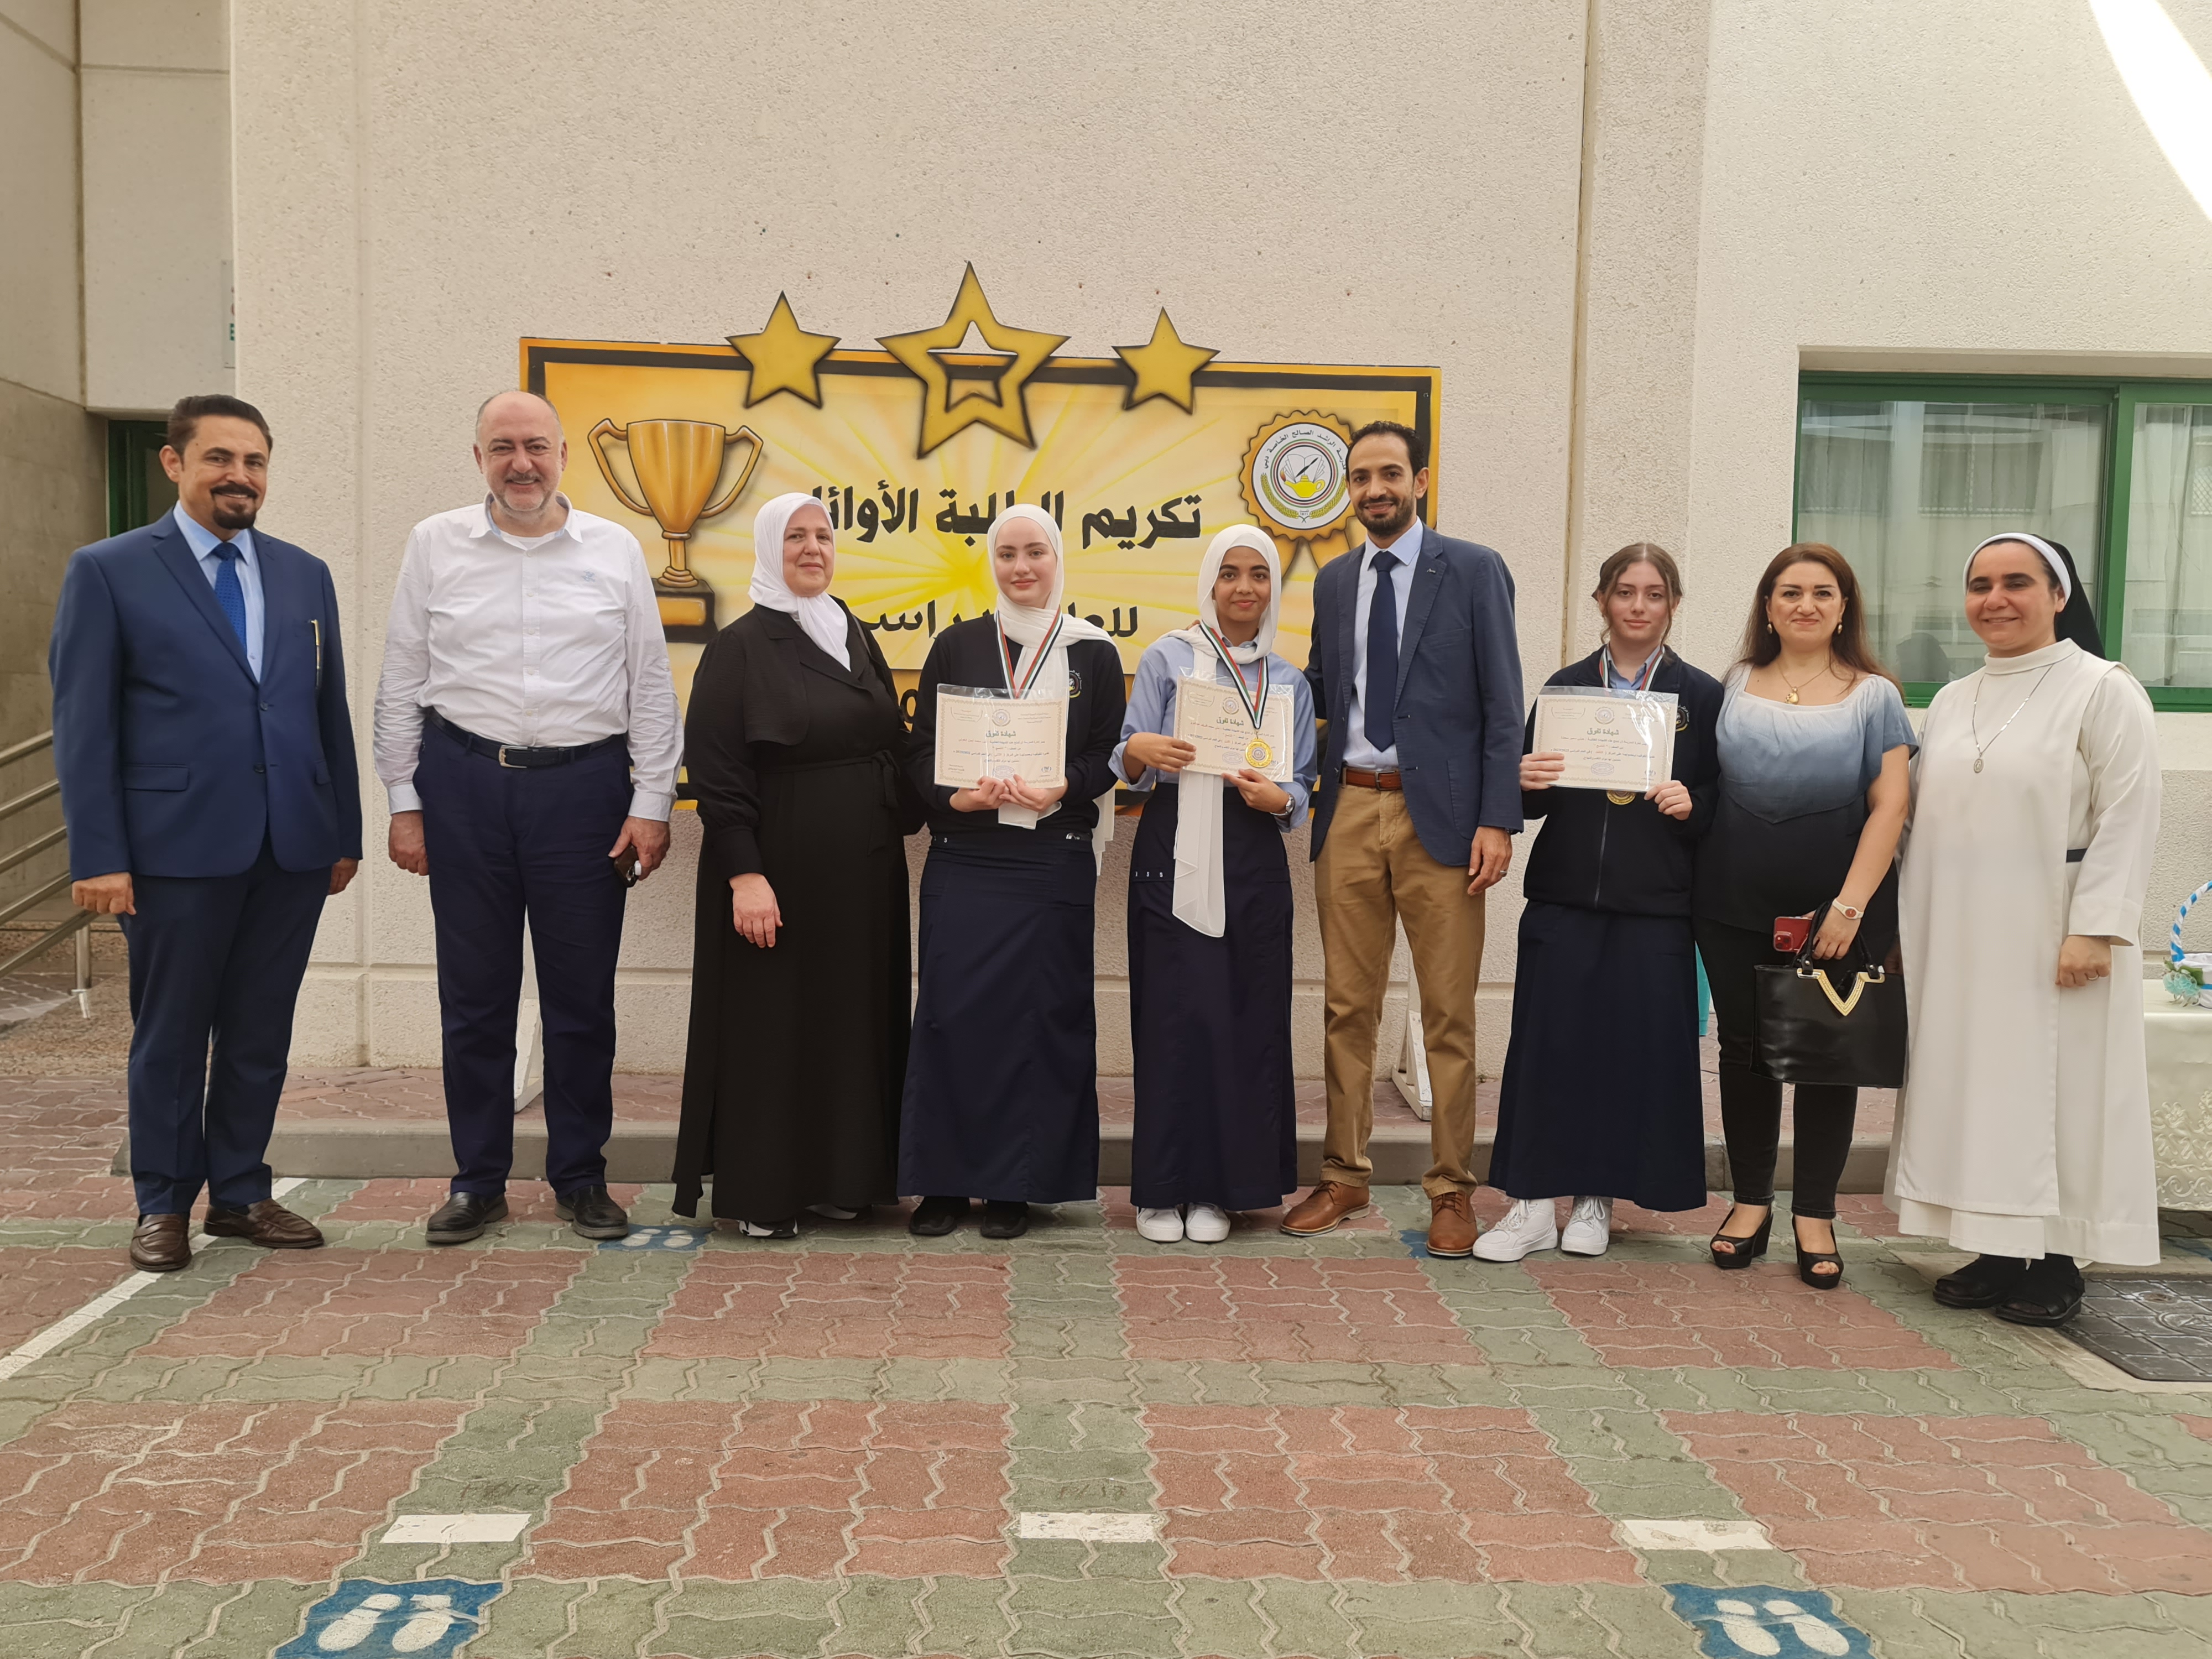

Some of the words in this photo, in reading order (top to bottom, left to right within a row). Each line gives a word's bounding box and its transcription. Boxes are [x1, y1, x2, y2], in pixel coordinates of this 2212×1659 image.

[1266, 434, 1288, 453] الخاصة
[1292, 430, 1314, 438] الصالح
[1317, 434, 1336, 448] الراشد
[812, 479, 919, 543] الأوائ
[936, 489, 1064, 547] اللبة
[1082, 494, 1202, 550] تكريم
